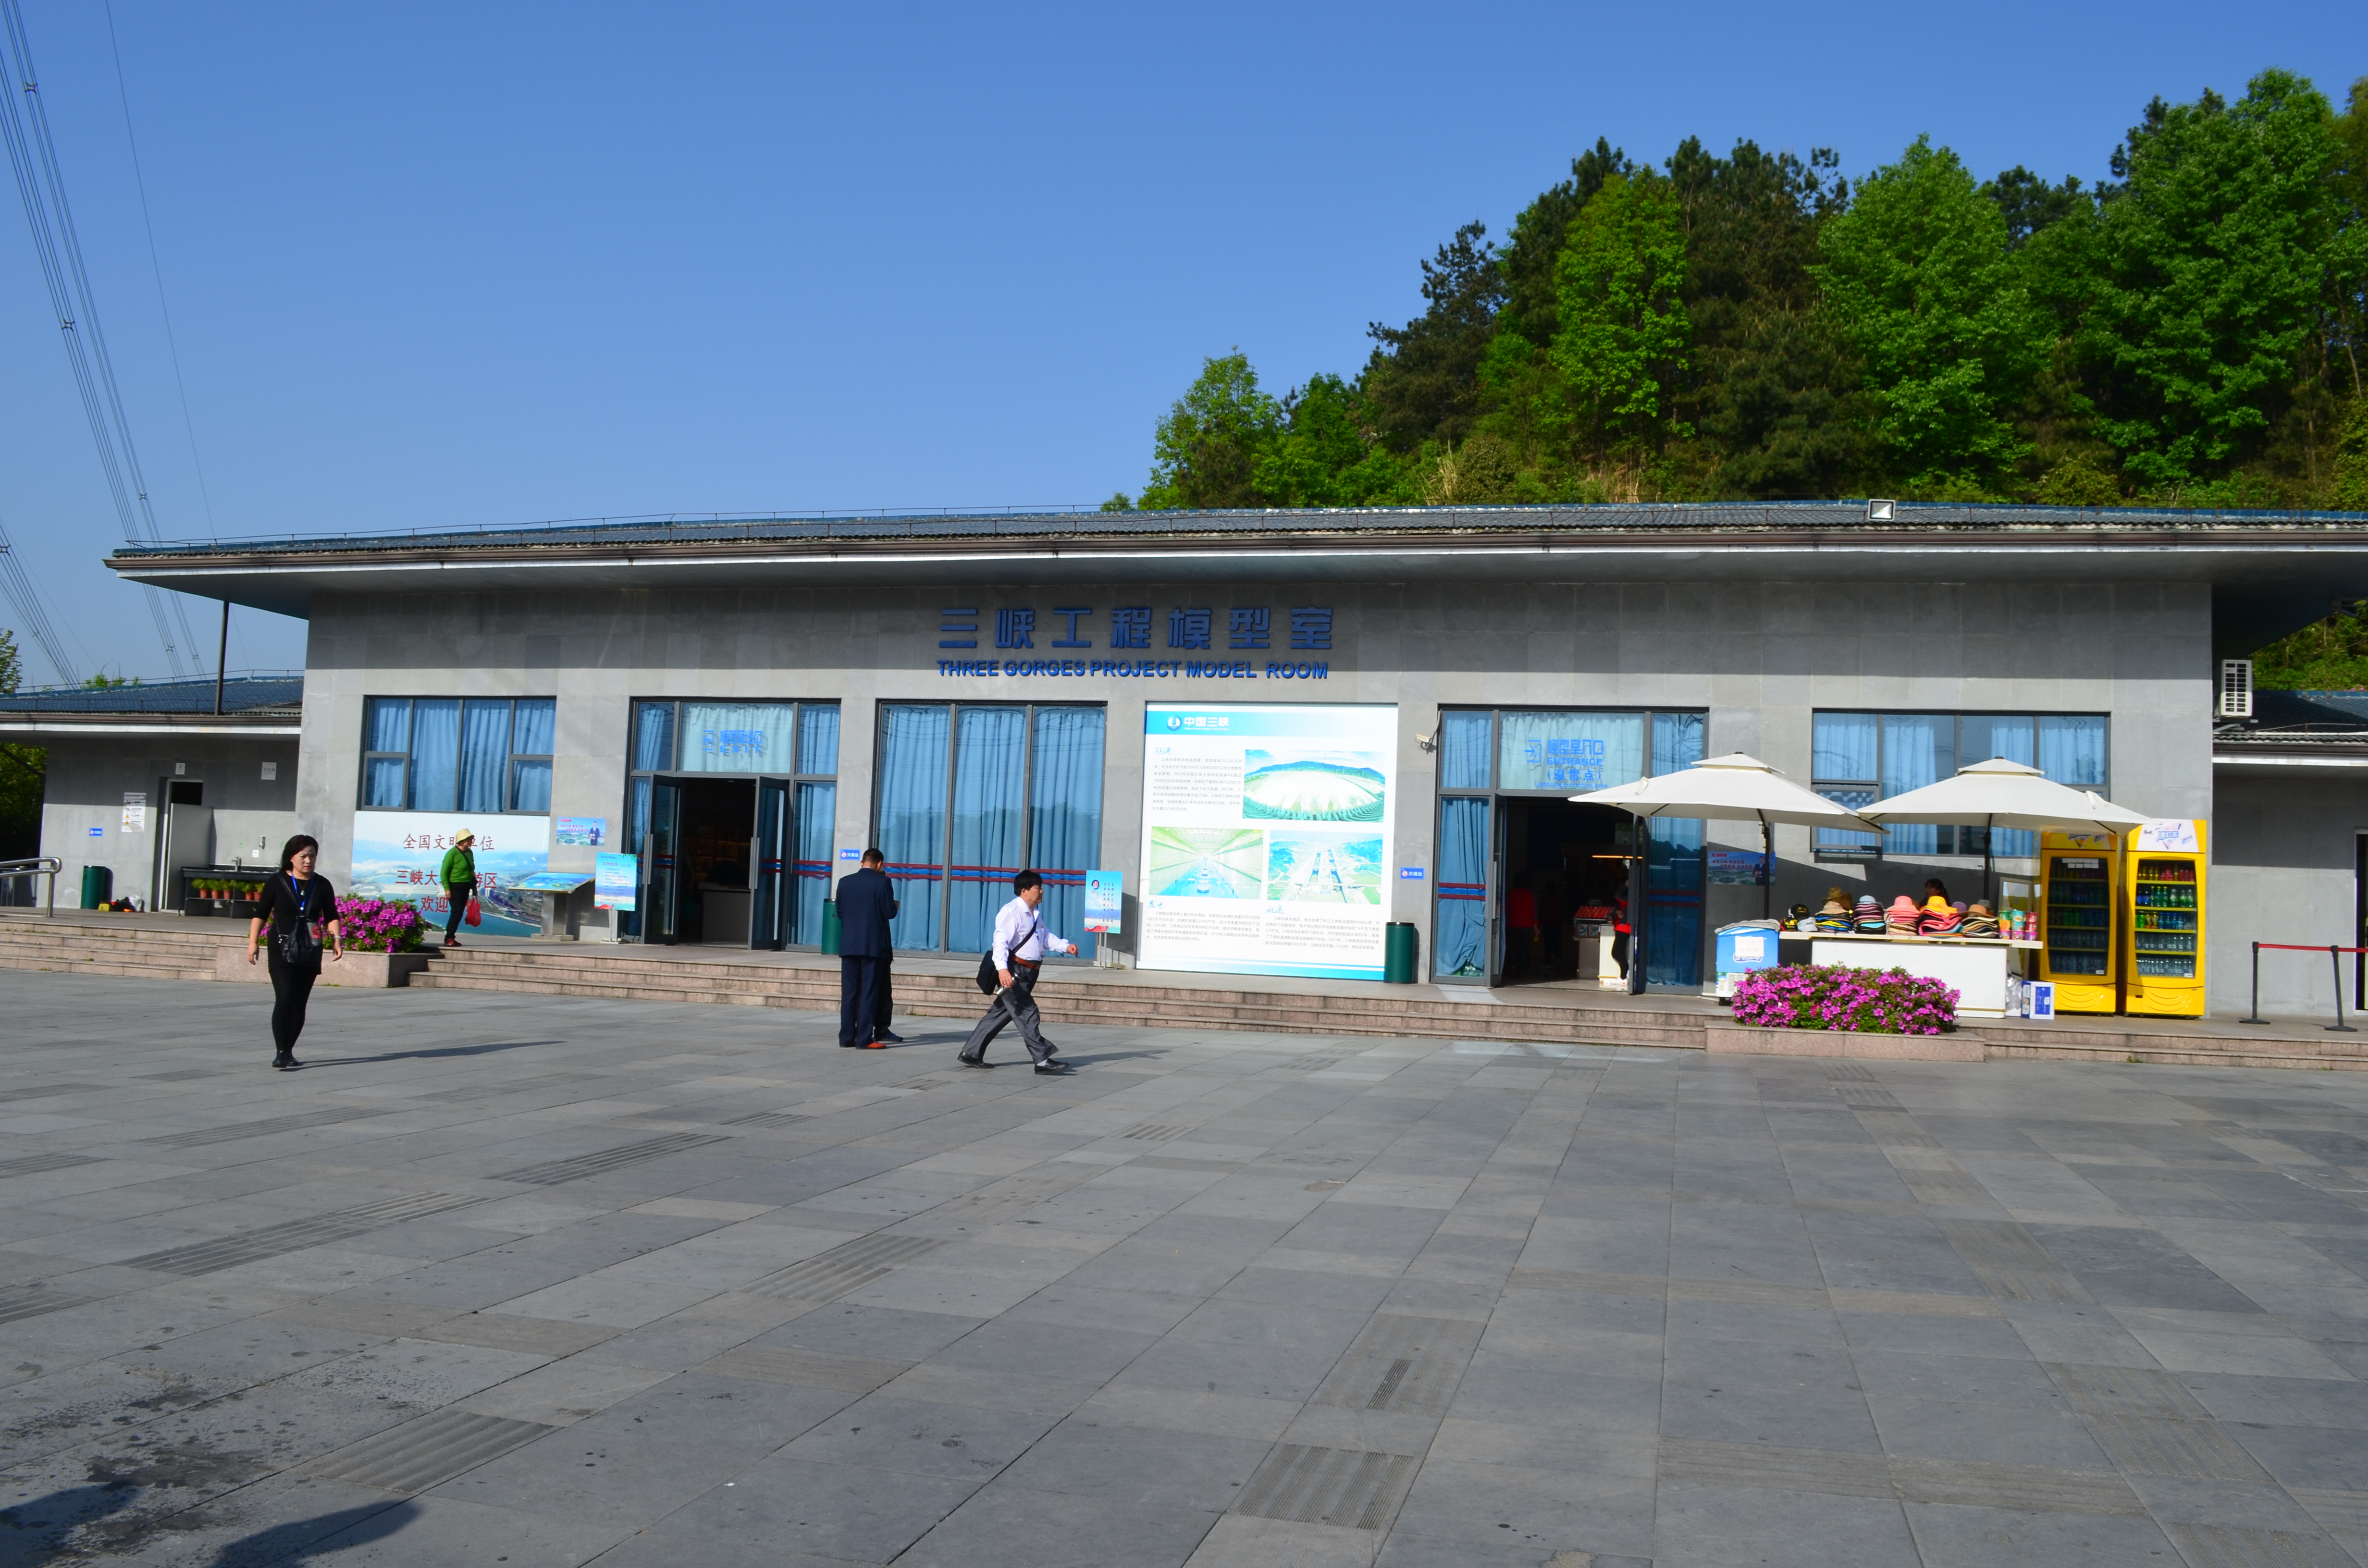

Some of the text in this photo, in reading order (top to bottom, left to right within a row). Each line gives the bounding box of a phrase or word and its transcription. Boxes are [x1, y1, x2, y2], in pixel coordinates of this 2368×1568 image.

[938, 607, 1332, 649] 三峡工程模型室
[937, 660, 1328, 679] THREE GORGES PROJECT MODEL ROOM
[1184, 716, 1229, 727] 中国三峡
[720, 730, 763, 744] 模型室出口
[1547, 739, 1604, 755] 模型室入口
[1546, 757, 1603, 766] ENTRANCE
[395, 870, 497, 888] 三峡大游区
